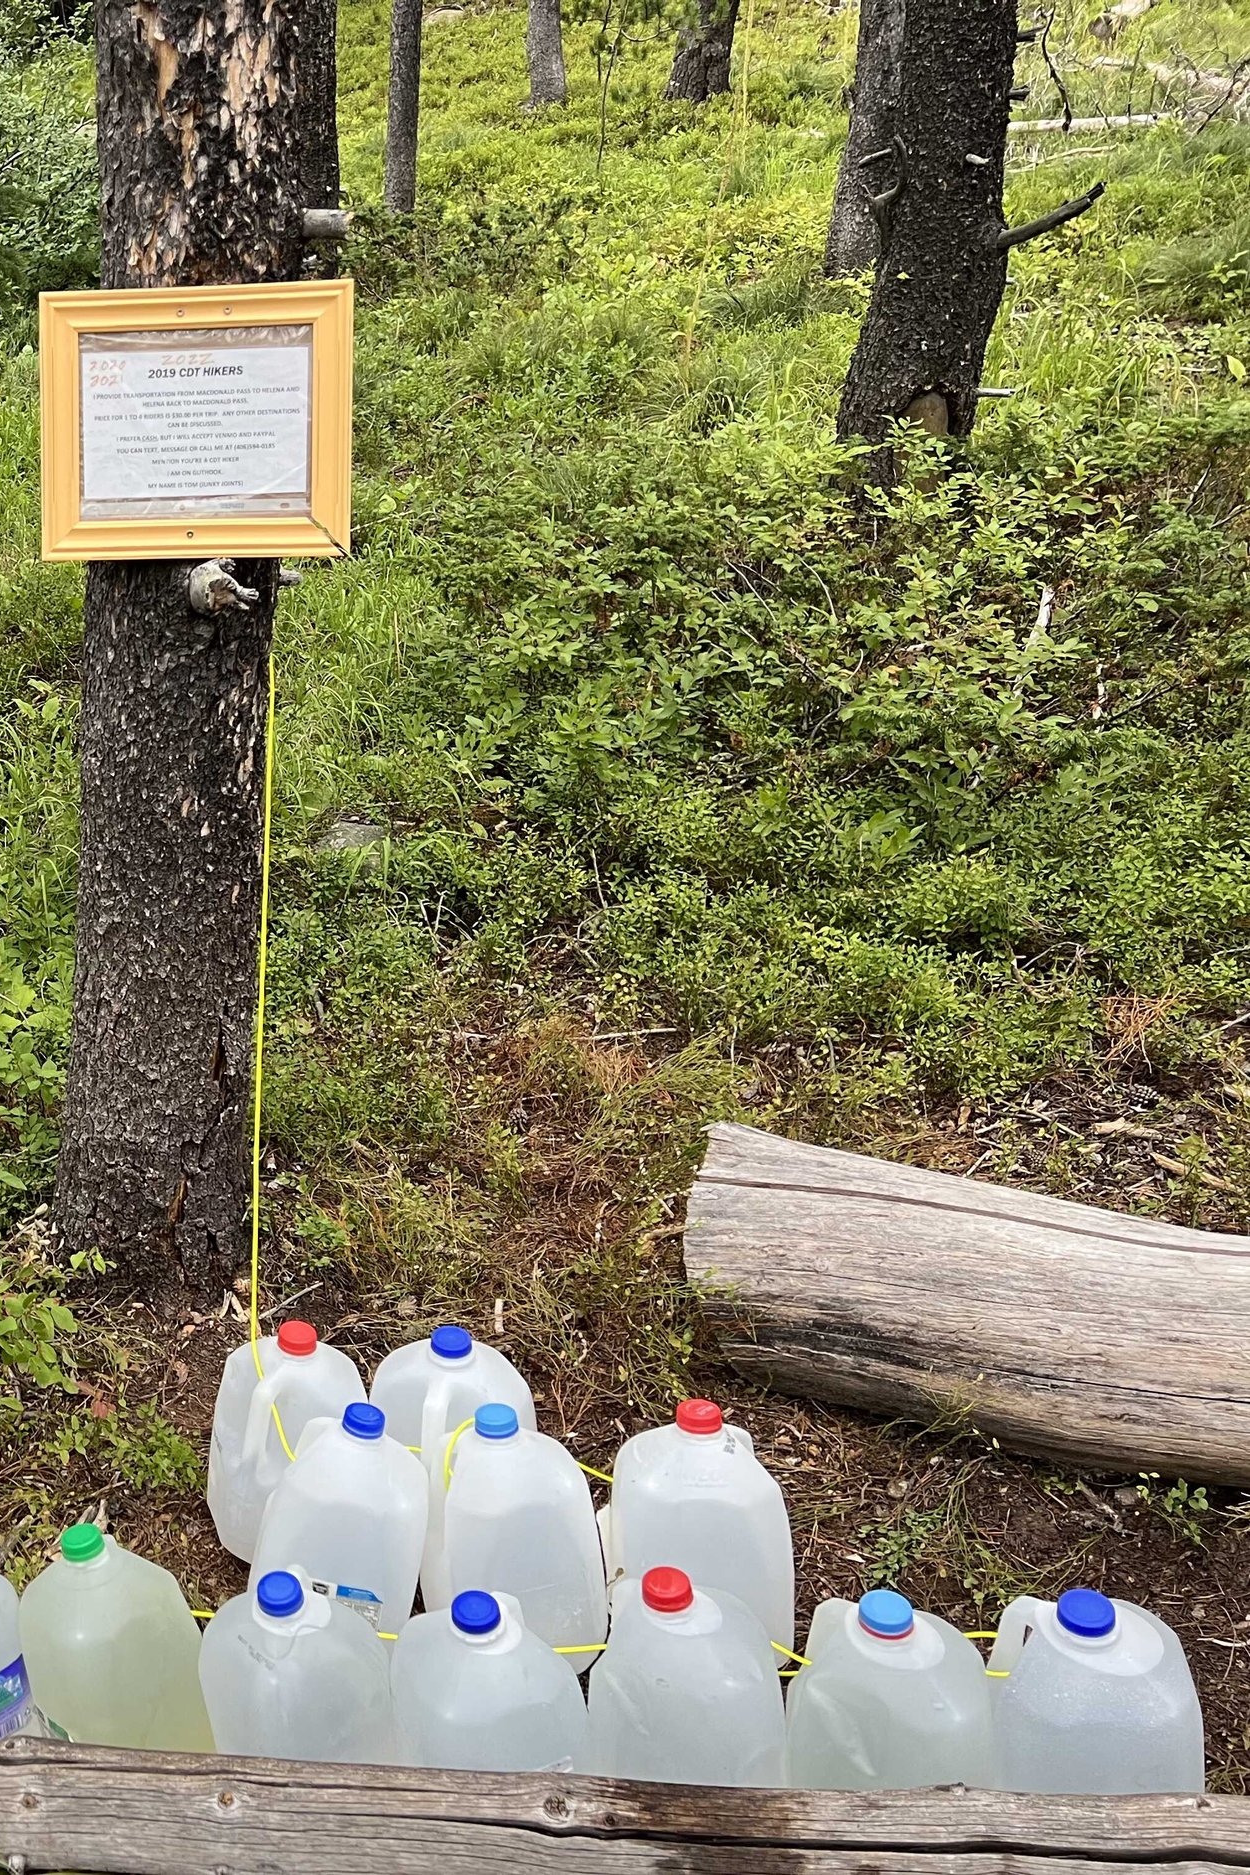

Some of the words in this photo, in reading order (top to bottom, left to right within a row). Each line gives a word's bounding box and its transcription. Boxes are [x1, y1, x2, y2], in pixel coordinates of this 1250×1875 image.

[161, 352, 215, 366] 2022
[89, 359, 126, 371] 2020
[148, 368, 176, 378] 2019
[179, 367, 200, 377] CDT
[203, 365, 243, 376] HIKERS
[123, 391, 176, 399] TRANSPORTATION
[257, 408, 300, 416] DESTINATIONS
[189, 420, 223, 428] DISCUSSED.
